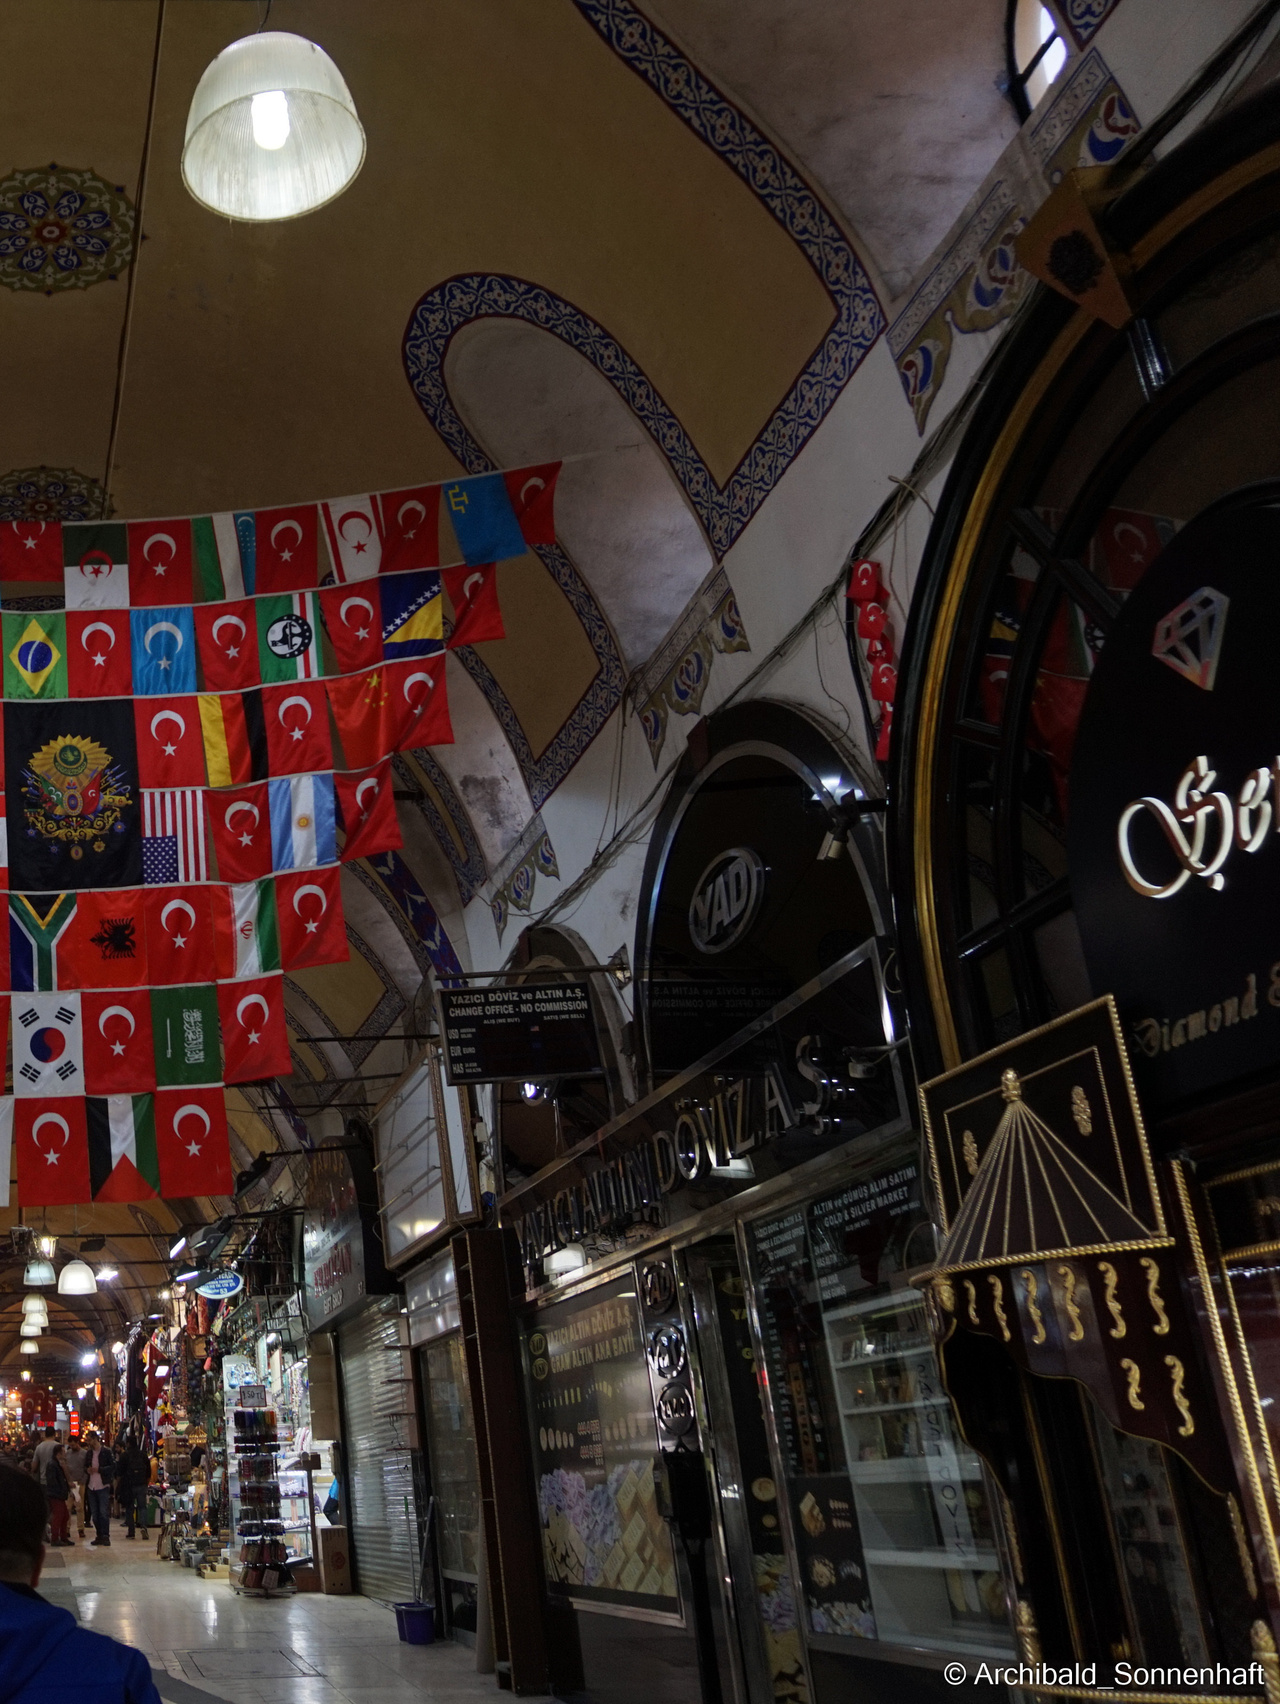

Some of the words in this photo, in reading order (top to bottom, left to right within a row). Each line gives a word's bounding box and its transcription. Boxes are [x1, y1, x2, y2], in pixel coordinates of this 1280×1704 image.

[449, 1006, 484, 1017] CHANGE
[485, 1005, 514, 1015] OFFICE
[520, 1003, 533, 1013] NO
[534, 1000, 588, 1012] COMMISSION
[450, 994, 485, 1005] YAZICI
[488, 990, 519, 1002] DÖVİZ
[535, 989, 563, 1000] ALTIN
[1131, 973, 1259, 1058] Diamond
[447, 1028, 460, 1039] USD
[450, 1045, 462, 1057] EUR
[652, 1075, 755, 1193] DÖVİZ
[813, 1200, 833, 1216] ALTIN
[834, 1198, 842, 1209] ve
[843, 1184, 868, 1206] GÜMÜŞ
[869, 1178, 888, 1194] ALIM
[889, 1166, 917, 1186] SATIMI
[824, 1213, 843, 1227] GOLD
[850, 1200, 876, 1219] SILVER
[876, 1186, 909, 1209] MARKET
[546, 1328, 570, 1344] YAZICI
[570, 1320, 591, 1340] ALTIN
[592, 1309, 615, 1334] DÖVİZ
[551, 1353, 572, 1375] GRAM
[572, 1346, 594, 1367] ALTIN
[595, 1340, 613, 1362] ANA
